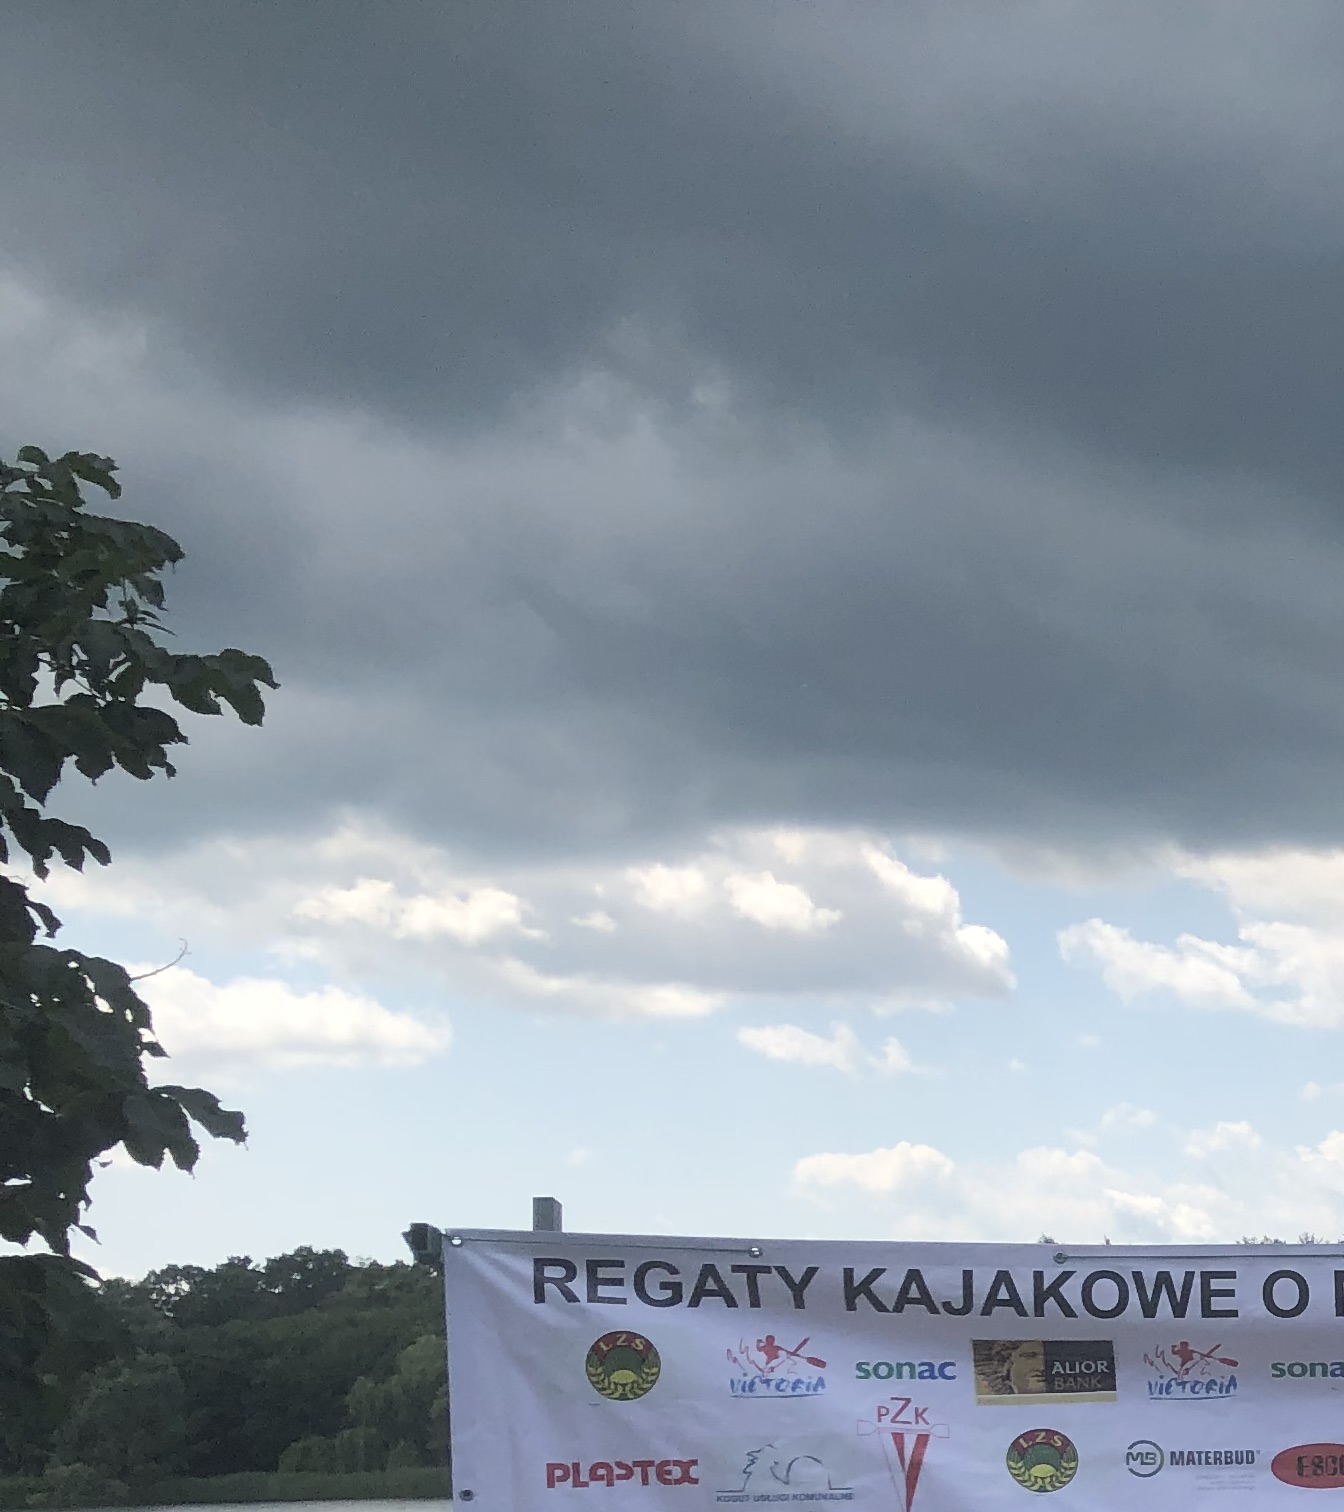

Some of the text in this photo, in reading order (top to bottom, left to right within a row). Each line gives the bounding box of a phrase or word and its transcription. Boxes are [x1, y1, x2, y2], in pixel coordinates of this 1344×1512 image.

[532, 1257, 820, 1310] REGATY
[842, 1267, 1239, 1319] KAJAKOWE
[1262, 1269, 1310, 1318] O
[855, 1360, 957, 1381] sonac
[1051, 1360, 1110, 1375] ALIOR
[1053, 1377, 1101, 1390] BANK
[876, 1397, 930, 1426] PZK
[1018, 1431, 1064, 1449] LZS
[1169, 1450, 1256, 1467] MATERBUD
